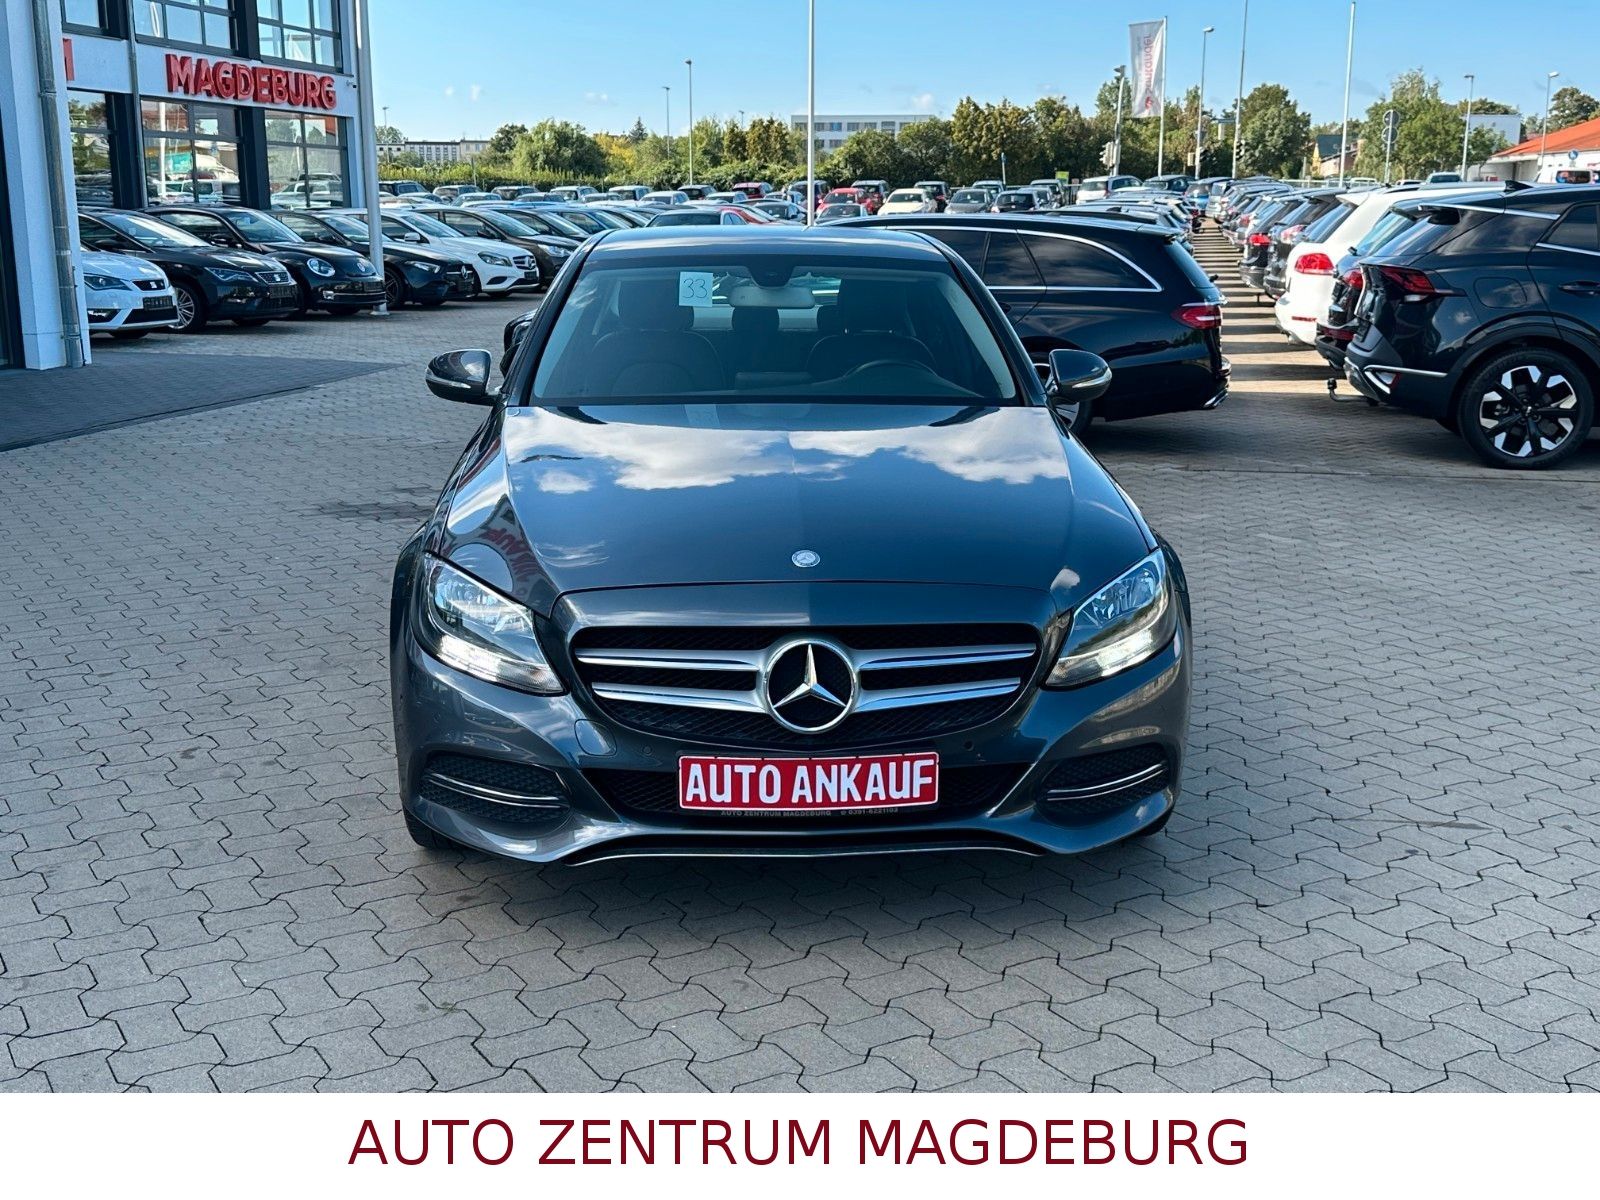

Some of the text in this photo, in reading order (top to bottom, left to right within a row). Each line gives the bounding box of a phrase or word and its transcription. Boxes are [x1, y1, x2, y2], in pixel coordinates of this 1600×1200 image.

[165, 54, 336, 109] MAGDEBURG
[682, 278, 708, 299] 33
[685, 759, 935, 804] AUTO ANKAUF
